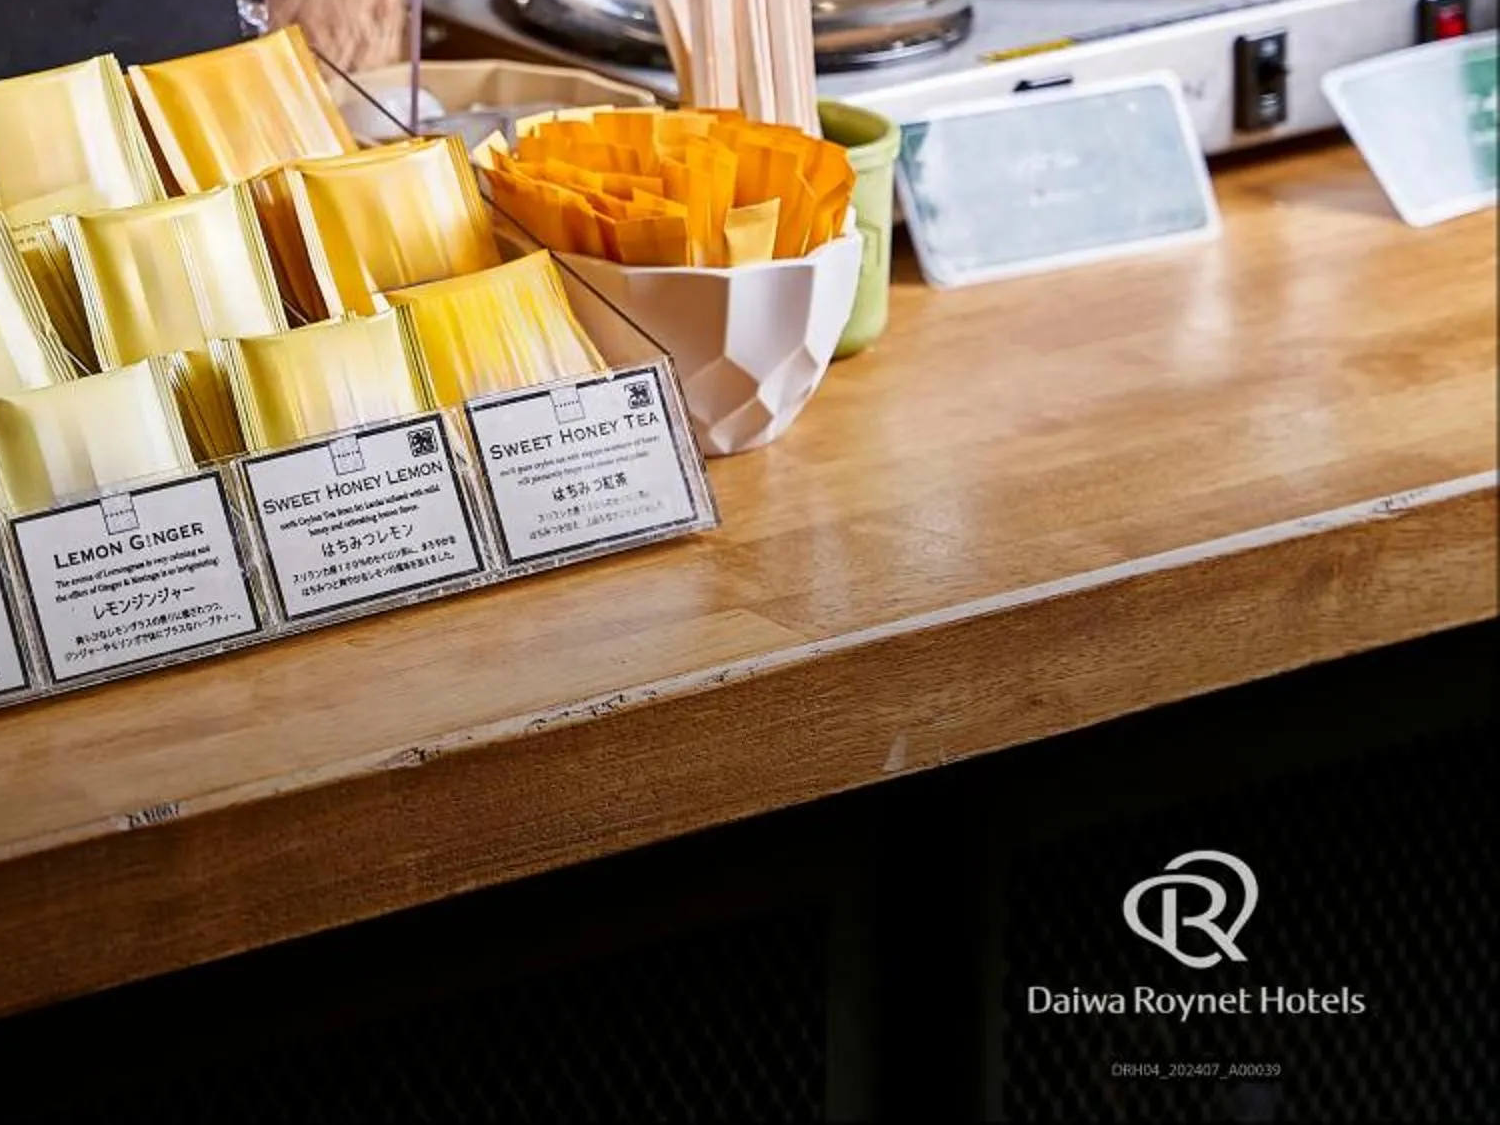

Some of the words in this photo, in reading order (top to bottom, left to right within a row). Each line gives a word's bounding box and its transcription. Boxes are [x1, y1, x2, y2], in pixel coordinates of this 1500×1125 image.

[489, 434, 553, 460] SWEET
[559, 420, 618, 444] HONEY
[622, 411, 659, 429] TEA
[262, 489, 321, 515] SWEET
[325, 474, 381, 500] HONEY
[385, 460, 444, 486] LEMON
[551, 471, 628, 502] はちみつ紅茶
[53, 540, 123, 570] LEMON
[129, 522, 205, 551] GINGER
[321, 524, 413, 558] はちみつレモン
[93, 586, 196, 620] レモンジンジャー
